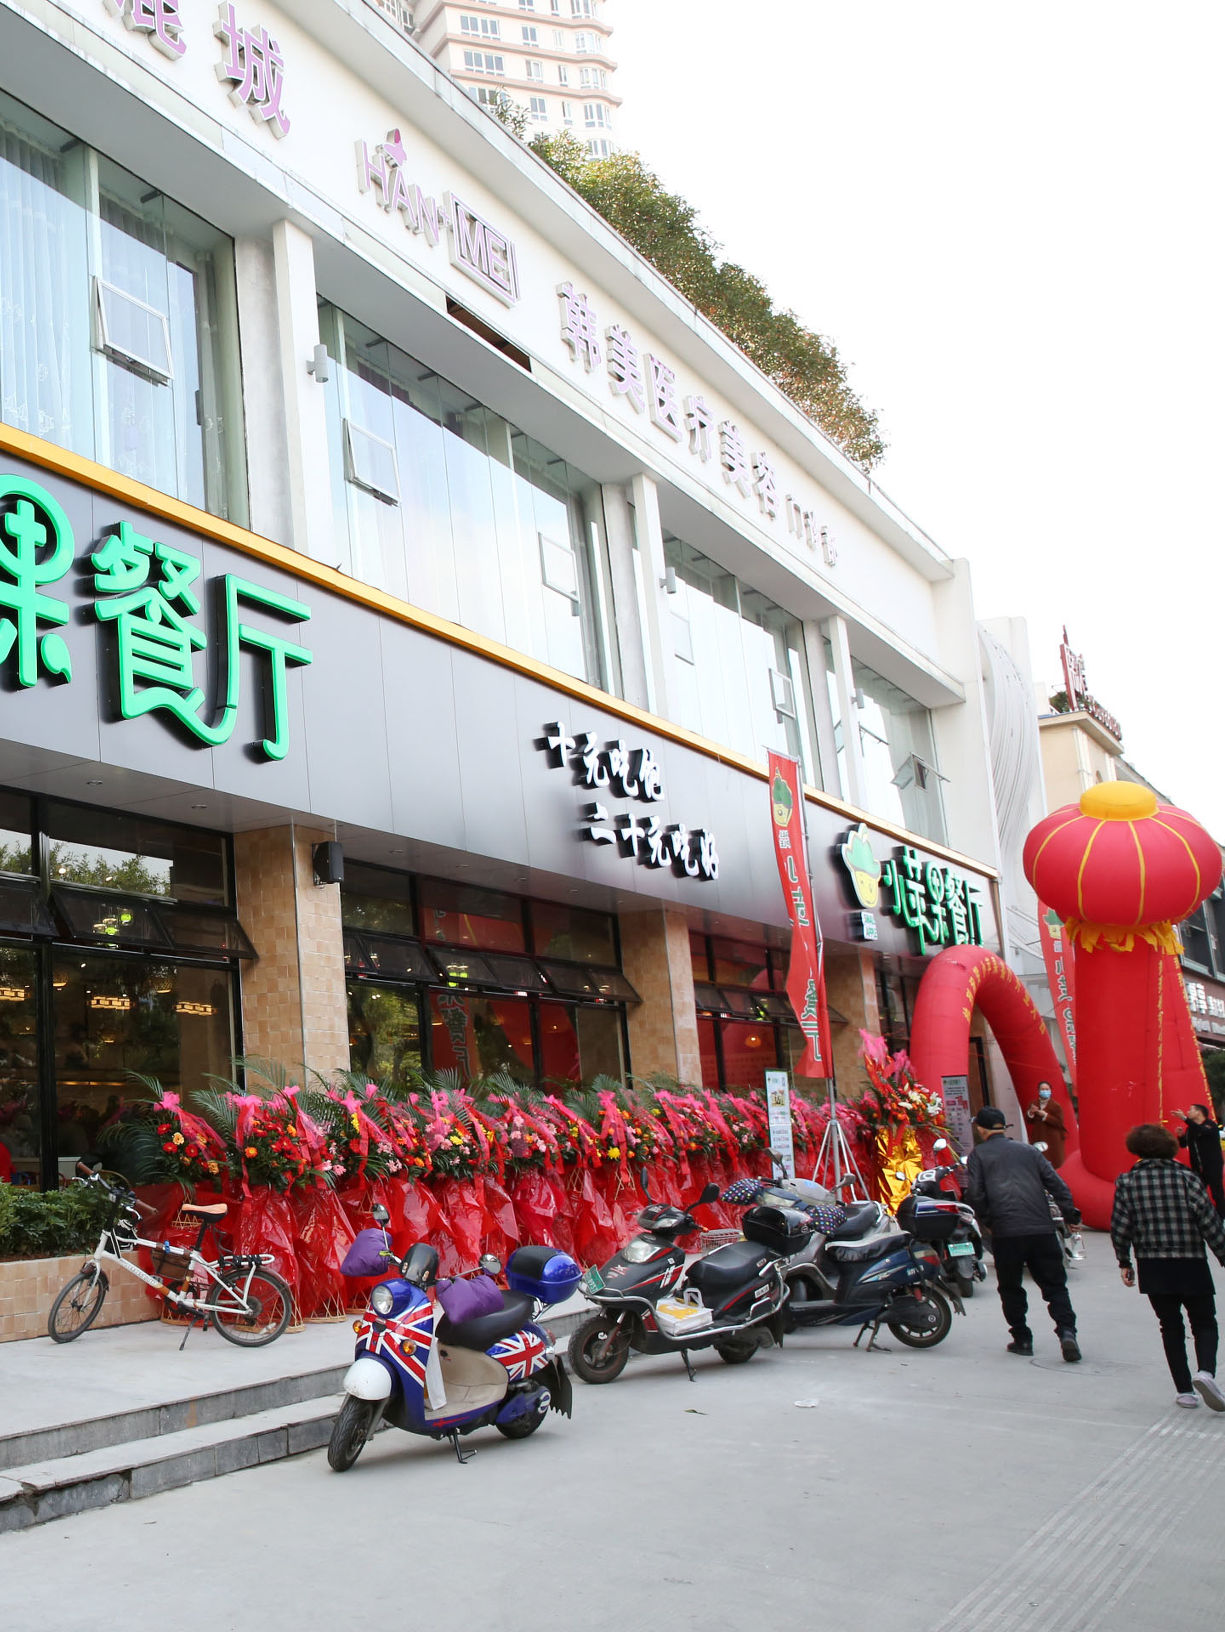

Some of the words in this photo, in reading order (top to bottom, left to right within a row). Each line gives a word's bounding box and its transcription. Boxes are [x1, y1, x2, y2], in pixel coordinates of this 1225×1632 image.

[543, 720, 665, 802] 十元吃饱
[588, 801, 720, 881] 二十元吃好
[882, 845, 985, 957] 小苹果餐厅
